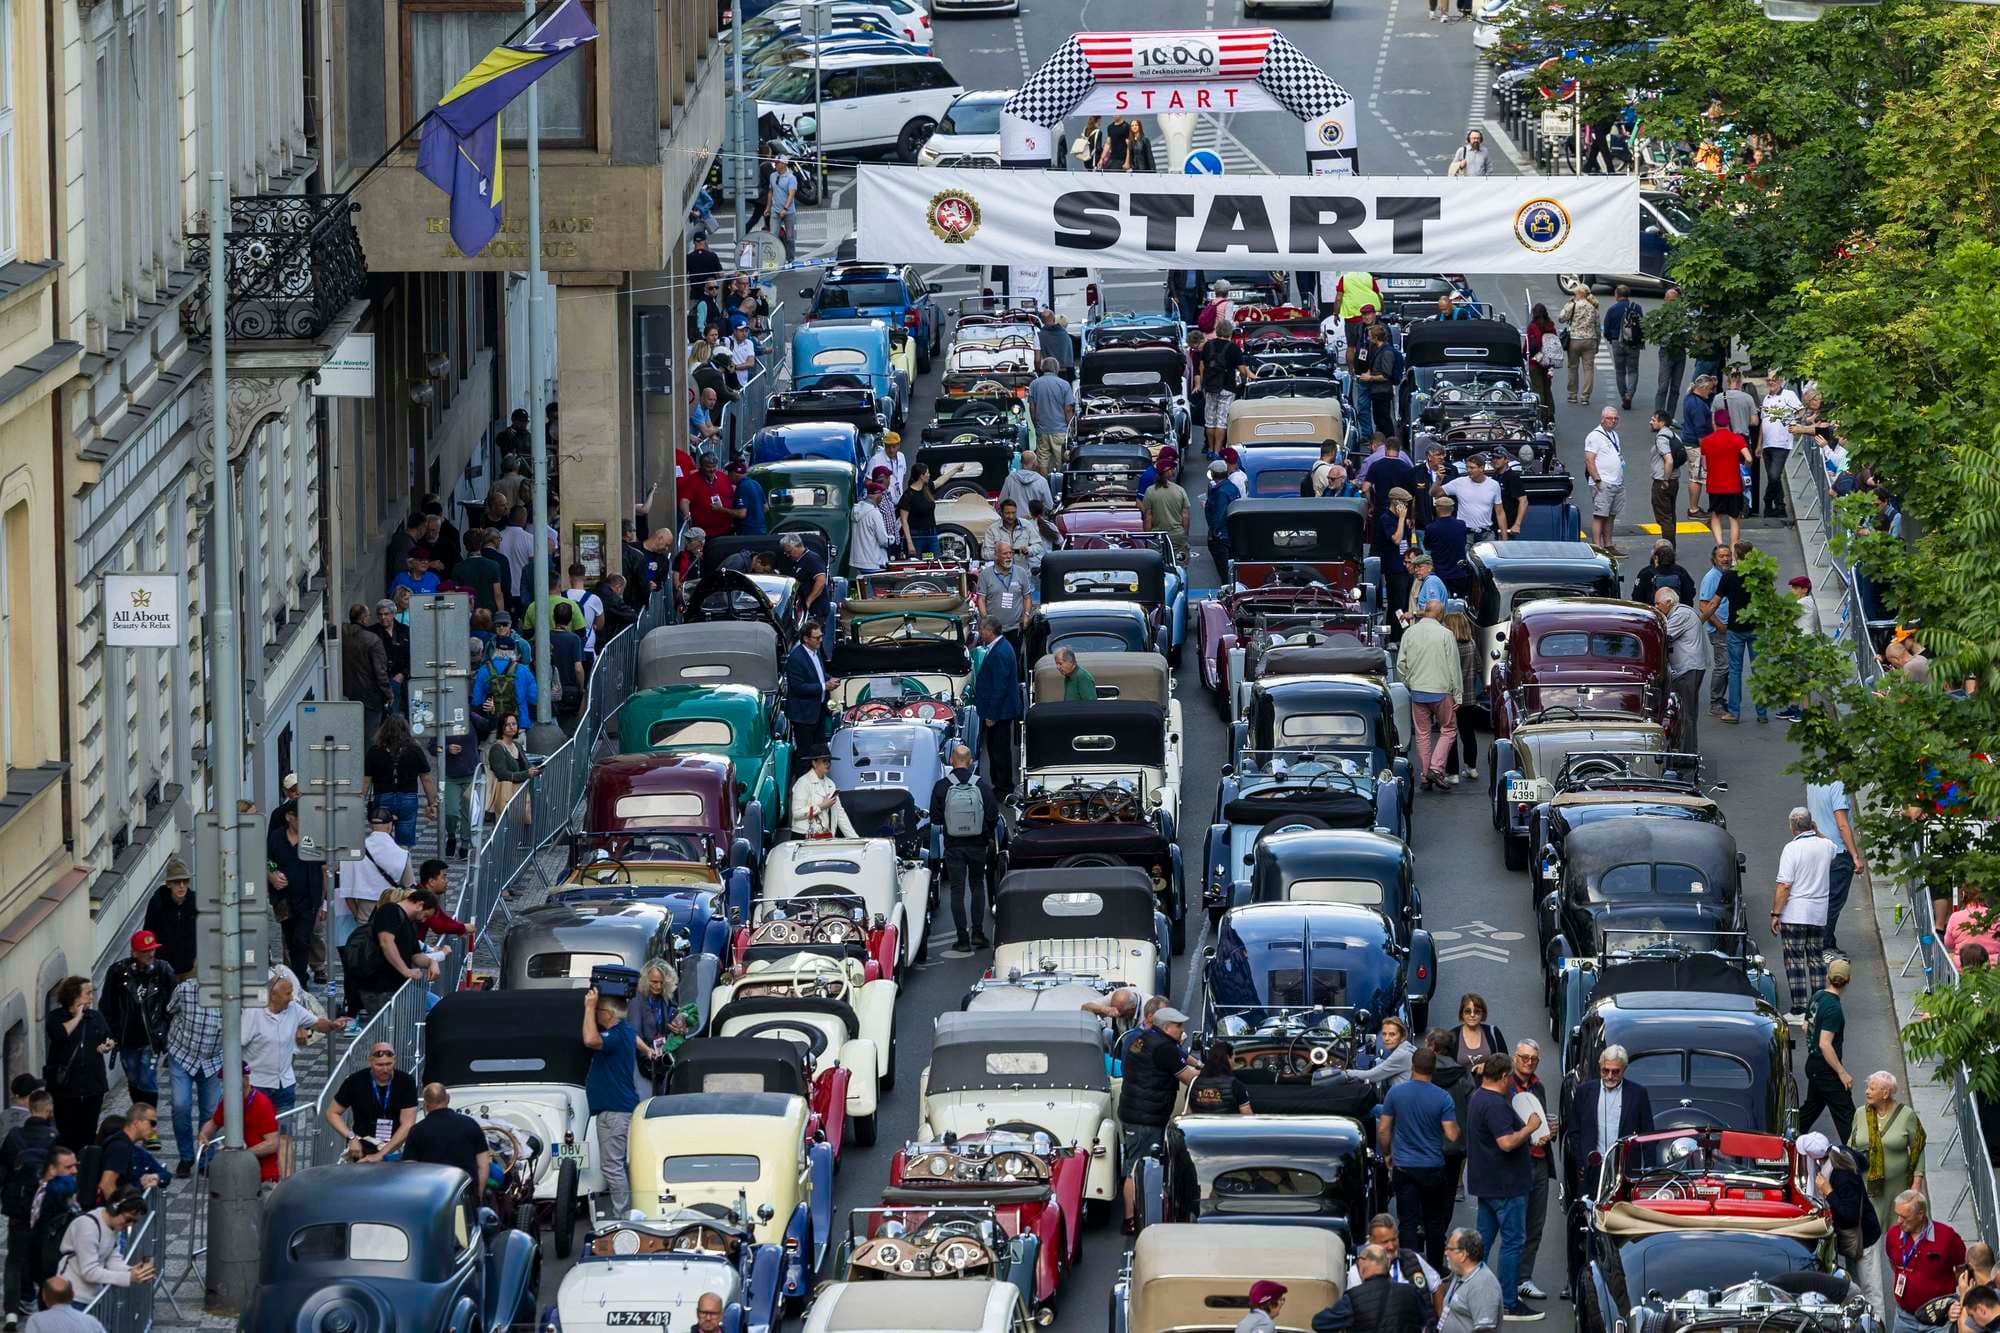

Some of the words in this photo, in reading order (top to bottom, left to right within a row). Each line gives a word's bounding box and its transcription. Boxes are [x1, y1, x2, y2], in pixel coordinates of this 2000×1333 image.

[1138, 47, 1214, 66] 1000
[1116, 89, 1239, 110] START
[1053, 190, 1441, 254] START
[112, 611, 129, 622] All
[132, 611, 170, 622] About
[113, 622, 139, 631] Beauty
[1512, 781, 1529, 790] 01V
[1512, 791, 1535, 800] 4399
[560, 1144, 581, 1155] 08V
